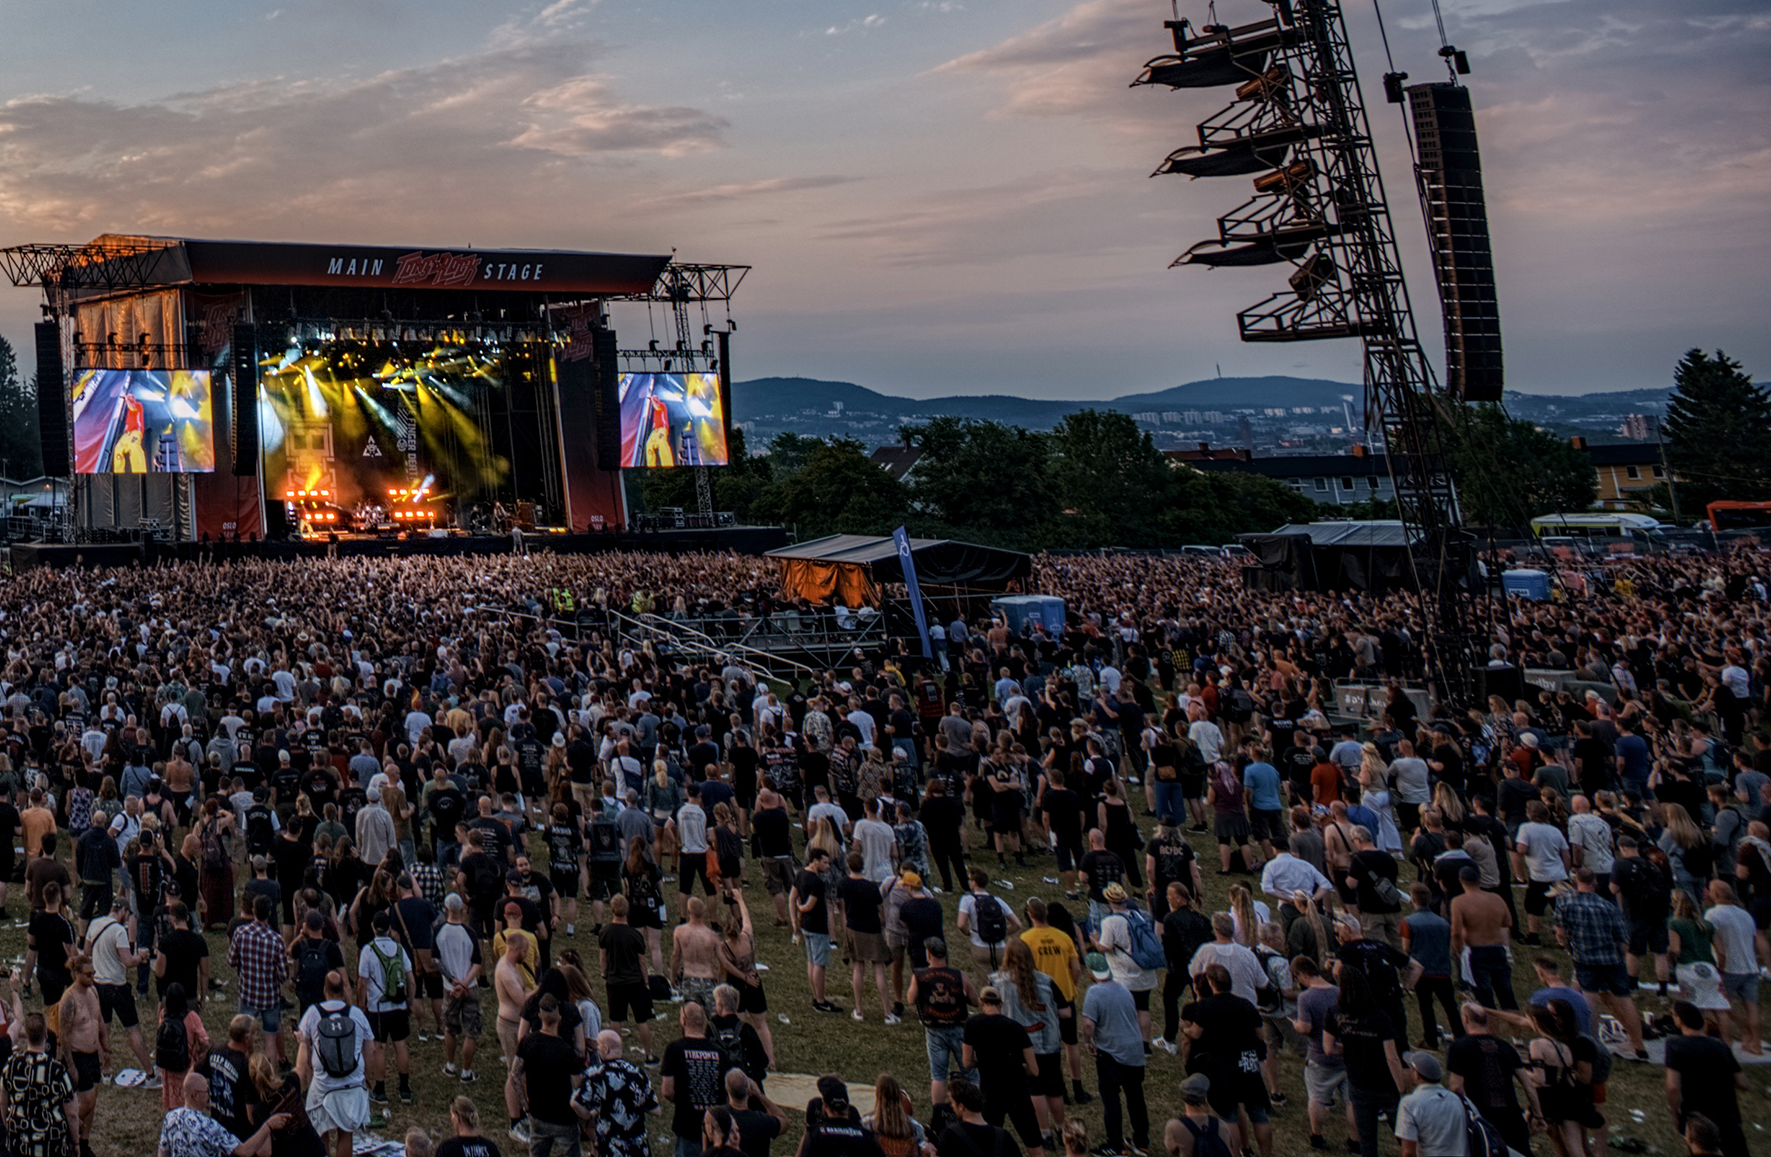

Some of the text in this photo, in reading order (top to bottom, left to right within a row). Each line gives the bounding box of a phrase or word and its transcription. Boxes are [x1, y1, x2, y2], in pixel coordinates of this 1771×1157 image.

[327, 257, 383, 276] MAIN
[483, 263, 543, 280] STAGE
[407, 417, 417, 451] FINGER
[1159, 844, 1184, 856] AC/DC
[1037, 946, 1061, 956] CREW
